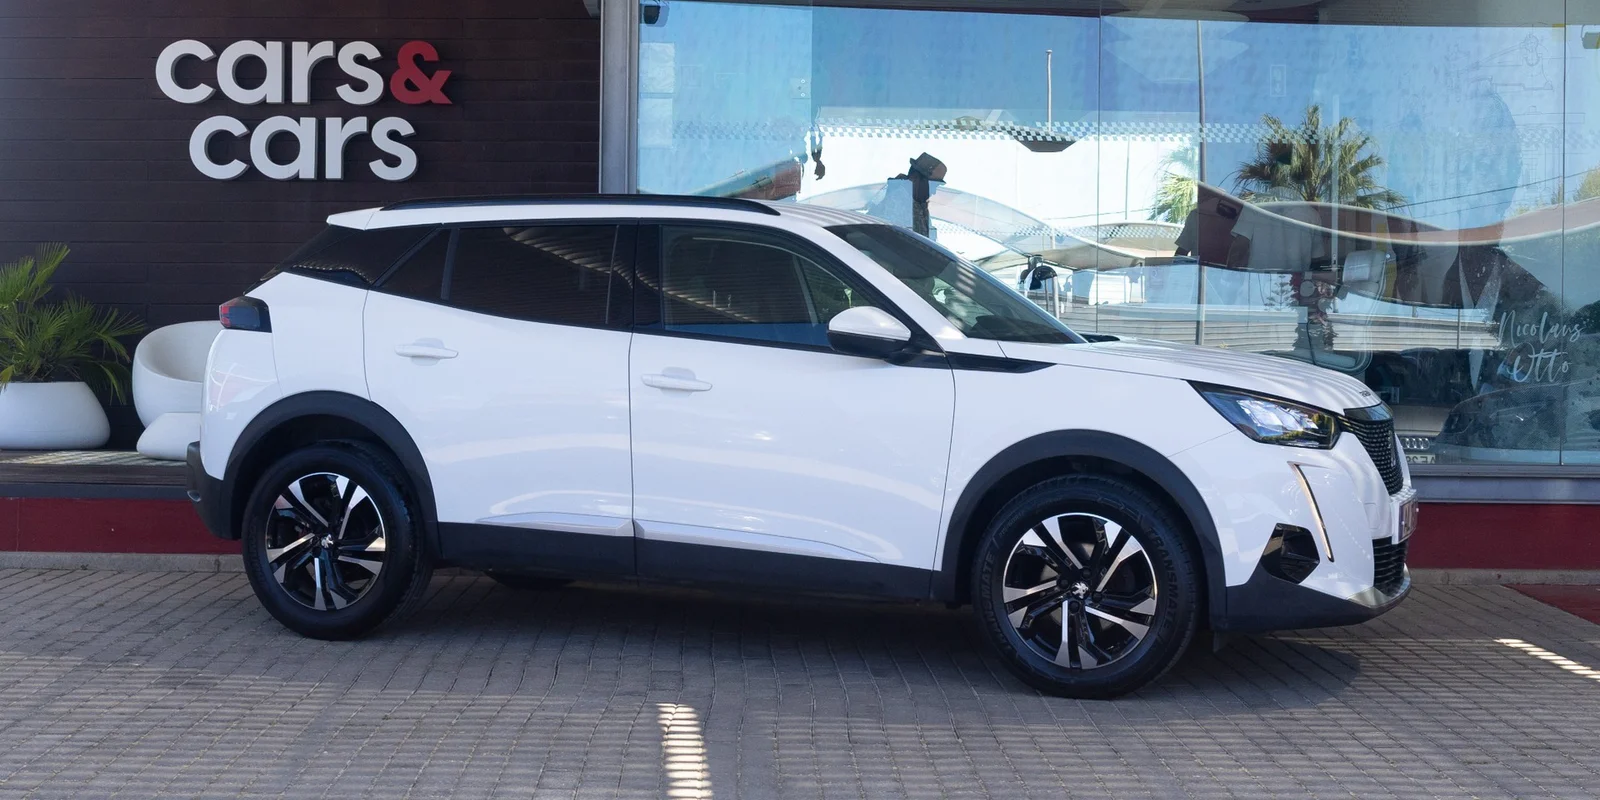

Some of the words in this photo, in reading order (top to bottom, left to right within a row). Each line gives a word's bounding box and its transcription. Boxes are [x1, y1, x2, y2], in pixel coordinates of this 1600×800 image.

[189, 115, 418, 180] cars
[1506, 342, 1572, 382] Otto
[1147, 527, 1177, 629] TRANSMATE
